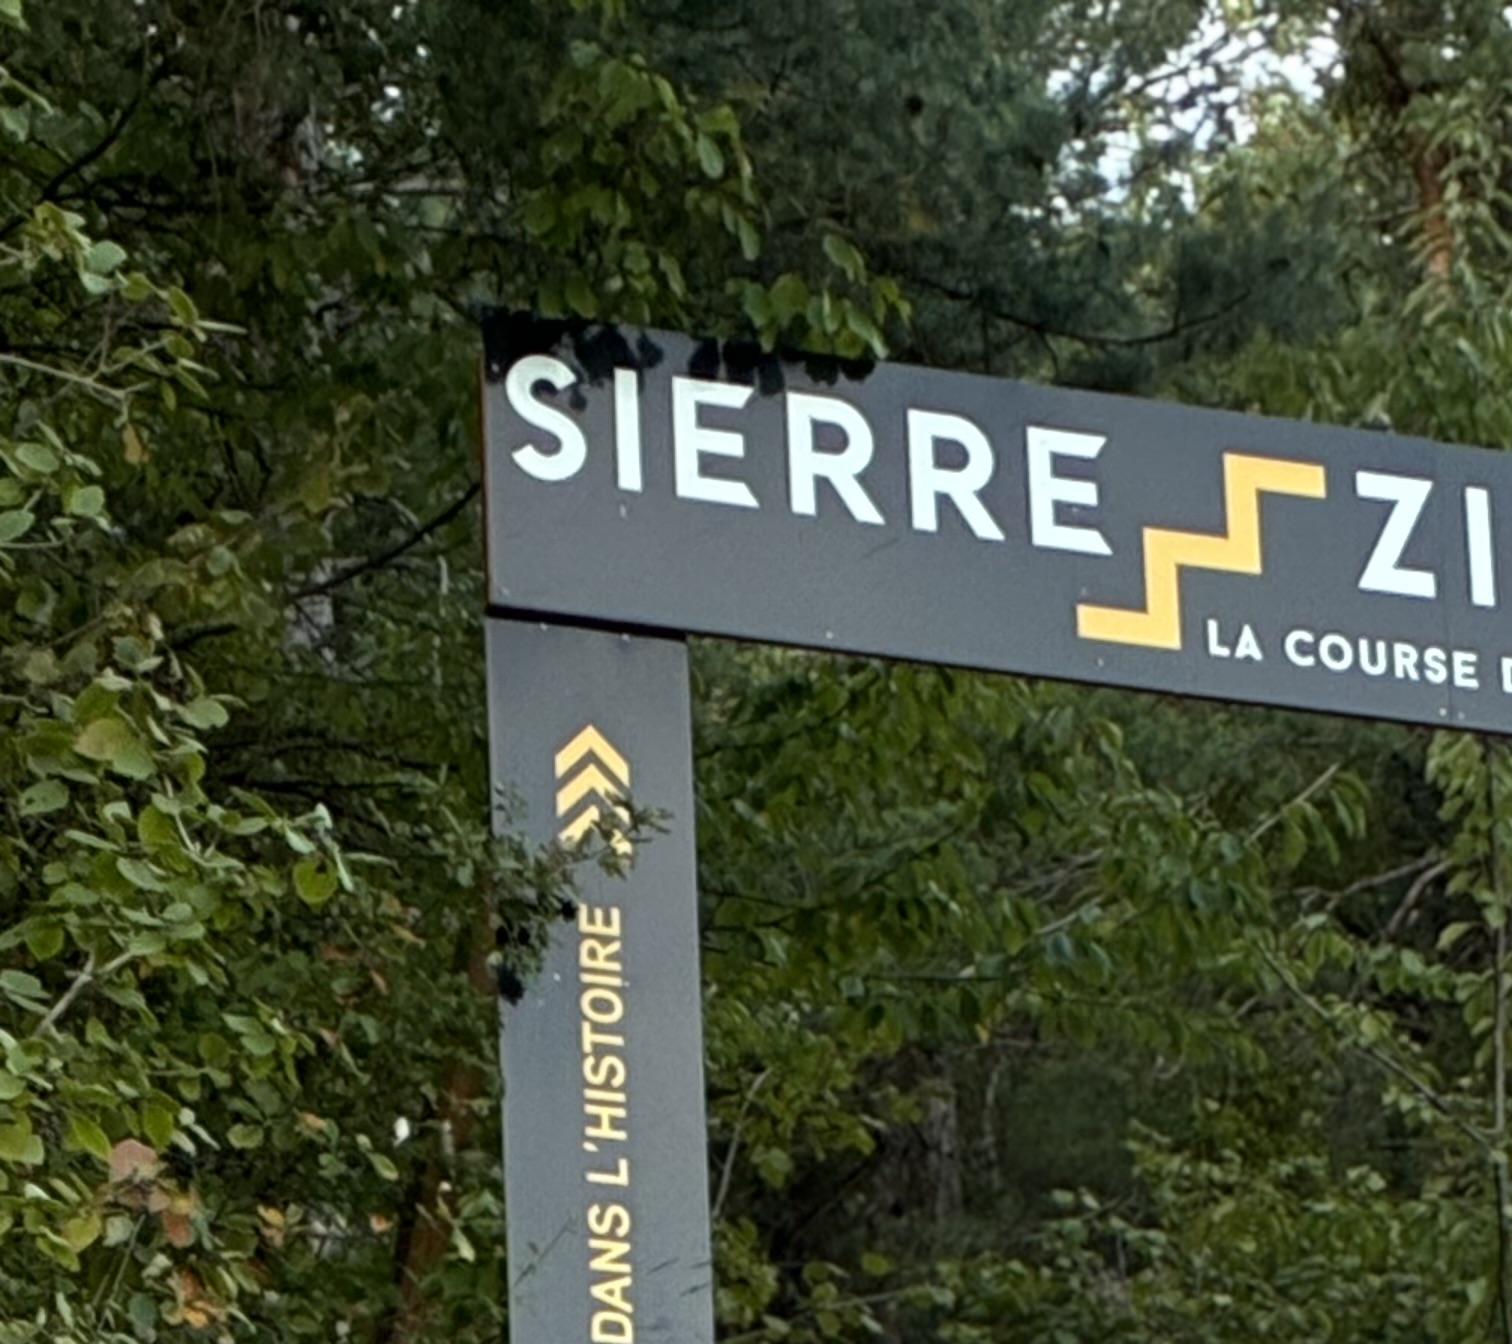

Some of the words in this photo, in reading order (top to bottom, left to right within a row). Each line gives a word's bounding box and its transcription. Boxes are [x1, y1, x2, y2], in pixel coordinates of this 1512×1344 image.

[505, 354, 1113, 556] SIERRE
[1206, 617, 1264, 662] LA
[1283, 629, 1481, 690] COURSE
[577, 902, 630, 1187] L'HISTOIRE
